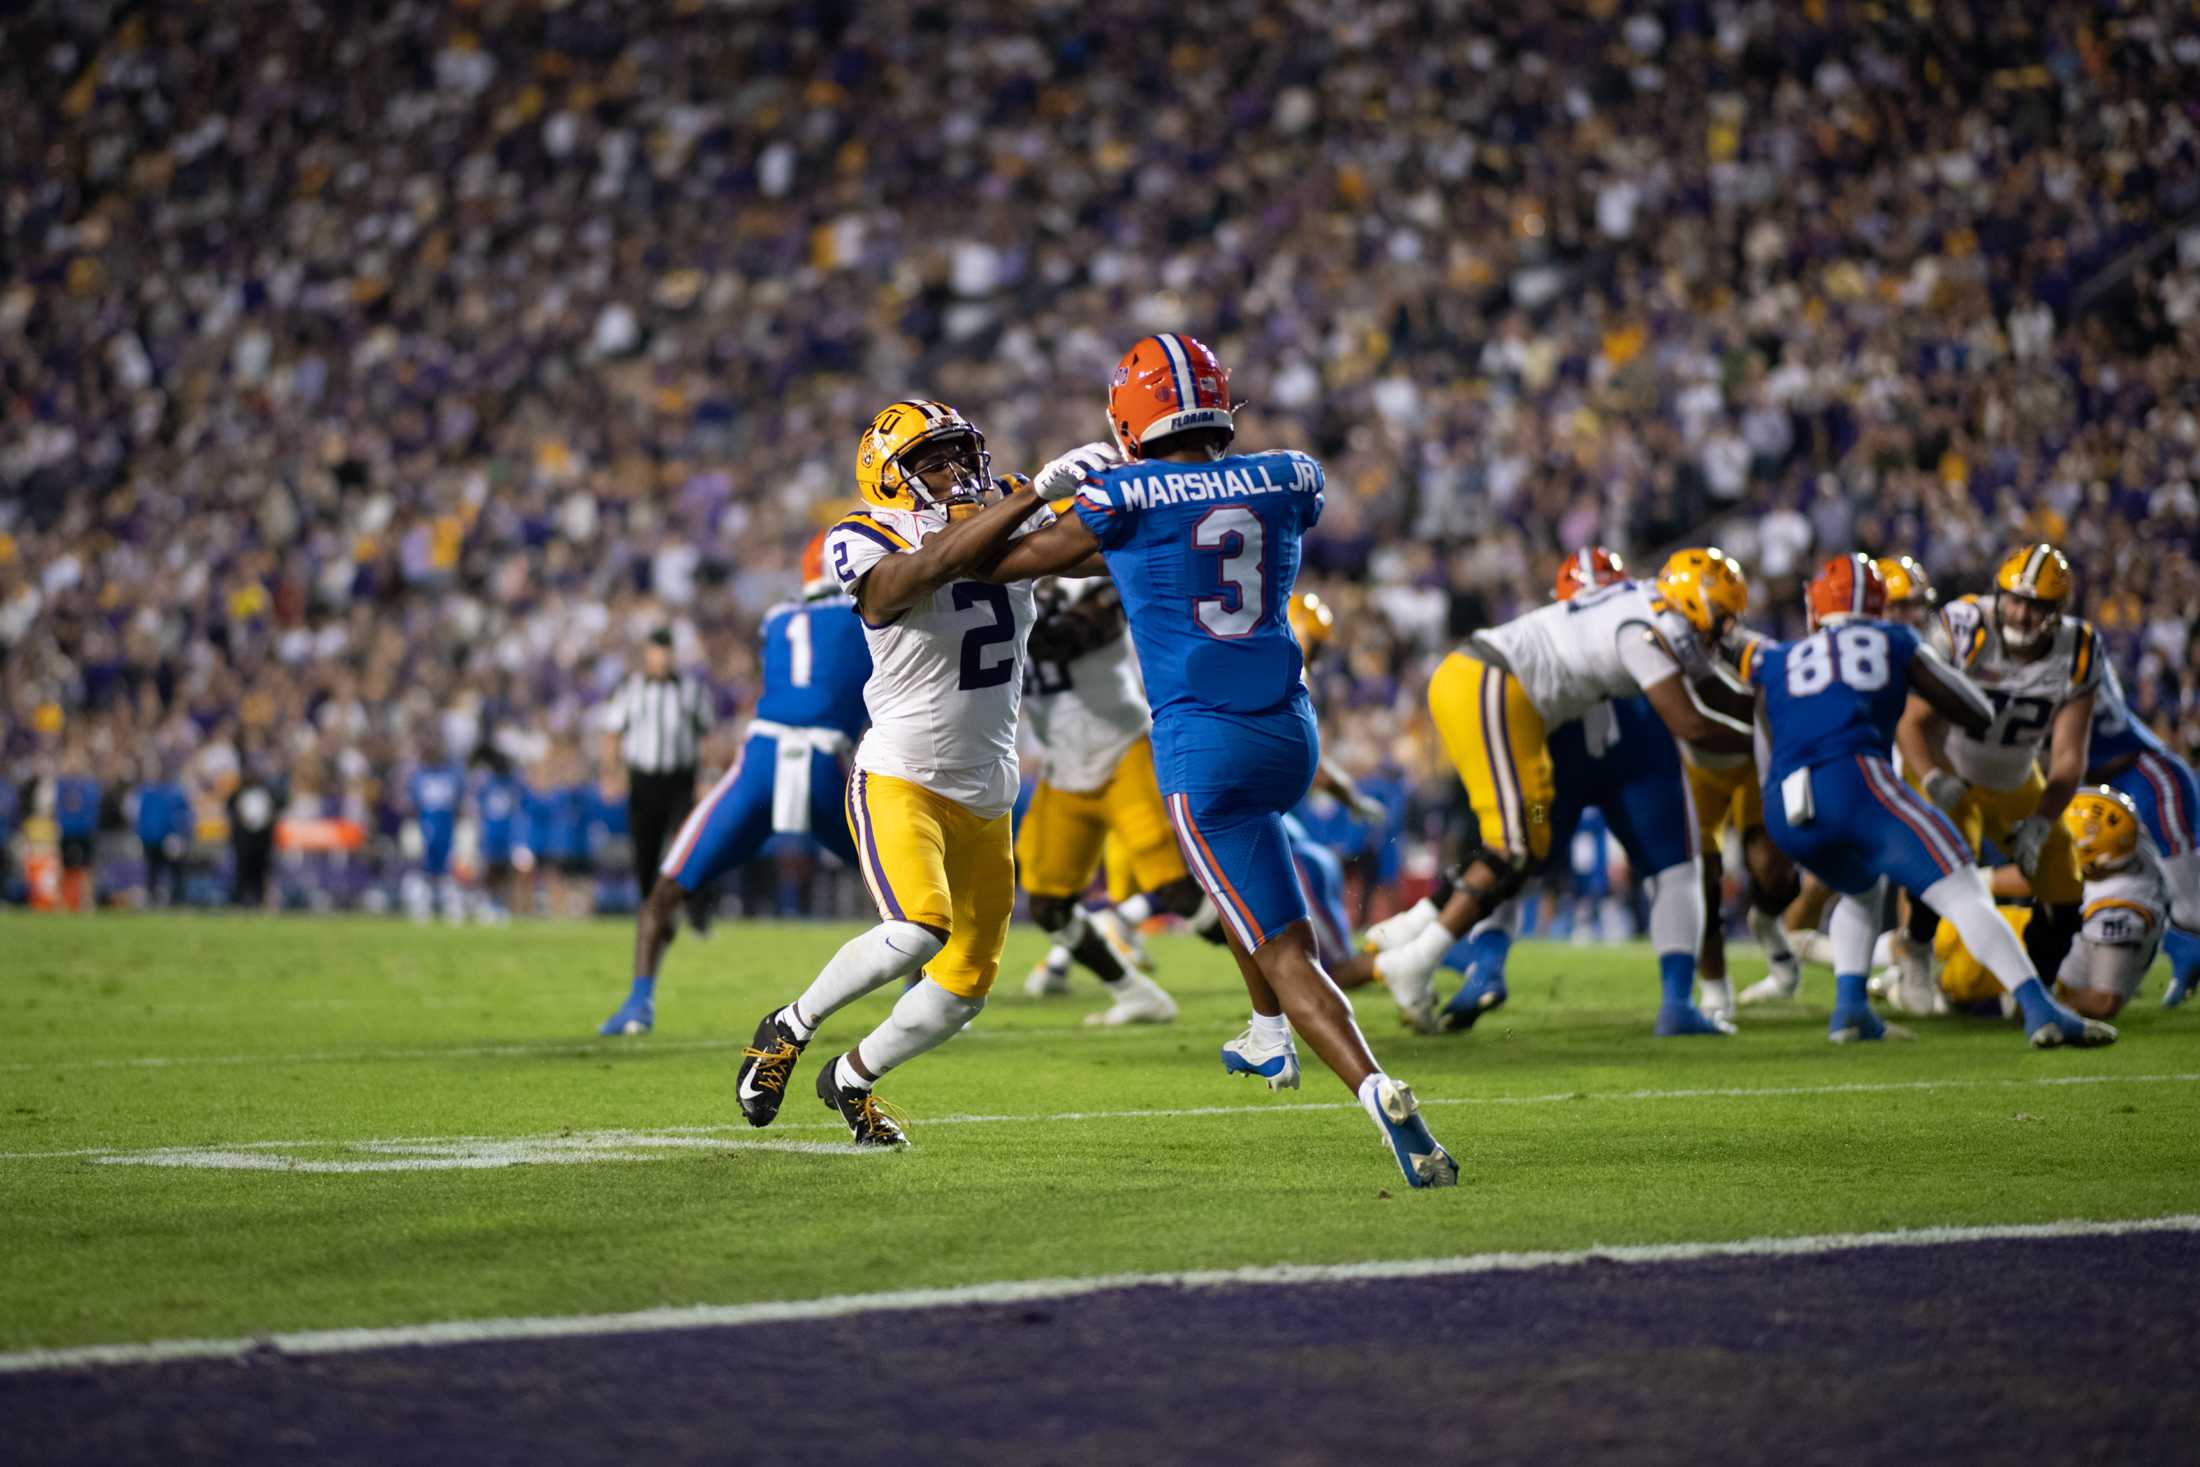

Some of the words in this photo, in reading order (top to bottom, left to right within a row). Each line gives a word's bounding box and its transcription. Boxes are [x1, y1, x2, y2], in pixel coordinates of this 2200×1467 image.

[1171, 411, 1215, 430] FLORIDA
[1119, 465, 1283, 513] MARSHALL
[832, 540, 857, 584] 2
[1191, 504, 1266, 640] 3
[785, 612, 813, 688] 1
[951, 580, 1016, 691] 2
[1787, 625, 1890, 698] 88
